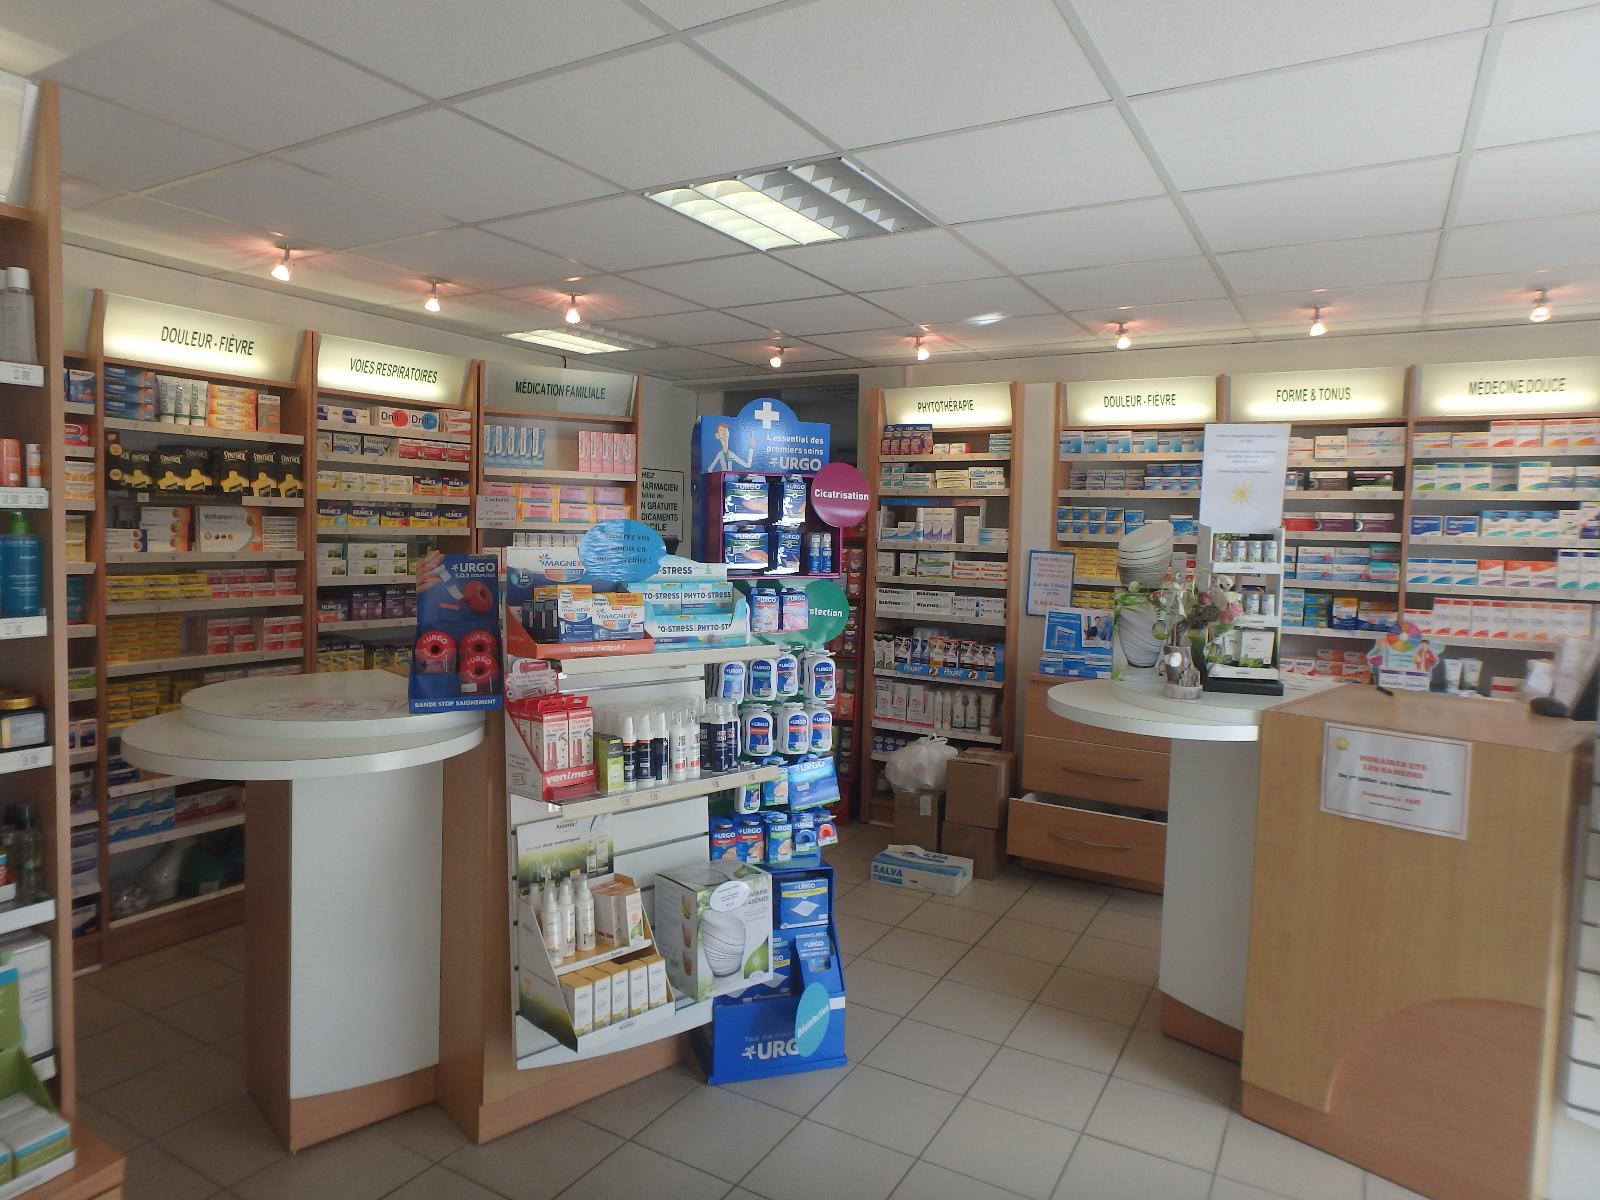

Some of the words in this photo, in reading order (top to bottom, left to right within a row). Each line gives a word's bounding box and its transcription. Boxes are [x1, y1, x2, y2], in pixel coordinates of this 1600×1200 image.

[161, 326, 213, 349] DOULEUR
[219, 334, 255, 356] FIÈVRE
[350, 357, 375, 374] VOIES
[376, 362, 438, 383] RESPIRATOIRES
[515, 378, 564, 397] MÉDICATION
[565, 385, 605, 399] FAMILIALE
[1468, 377, 1524, 395] MÉDECINE
[1526, 377, 1566, 393] DOUCE
[1104, 395, 1142, 408] DOULEUR
[1147, 392, 1176, 407] FIÈVRE
[1276, 388, 1308, 402] FORME
[1310, 388, 1316, 401] &
[1319, 387, 1351, 401] TONUS
[917, 398, 974, 413] PHYTOTHÉRAPIE
[381, 411, 400, 422] Drill
[411, 414, 430, 425] Drill
[766, 433, 809, 444] L'essentiel
[810, 435, 824, 445] des
[223, 450, 246, 461] SYNTHOL
[766, 445, 803, 455] premiers
[804, 446, 824, 456] soins
[253, 452, 274, 463] SYNTHOL
[779, 457, 822, 471] URGO
[740, 482, 761, 490] URGO
[814, 488, 869, 501] Cicatrisation
[647, 502, 678, 511] GRATUITE
[641, 512, 679, 522] DICAMENTS
[458, 562, 496, 572] URGO
[809, 608, 842, 618] otection
[426, 634, 448, 644] URGO
[470, 656, 492, 665] URGO
[415, 700, 436, 708] BANDE
[800, 760, 825, 772] URGO
[1360, 755, 1407, 768] HORAIRES
[1363, 764, 1380, 772] LES
[545, 769, 595, 785] venimex
[742, 827, 762, 835] URGO
[873, 864, 903, 878] SALVA
[797, 882, 816, 890] URGO
[757, 1039, 800, 1060] URG
